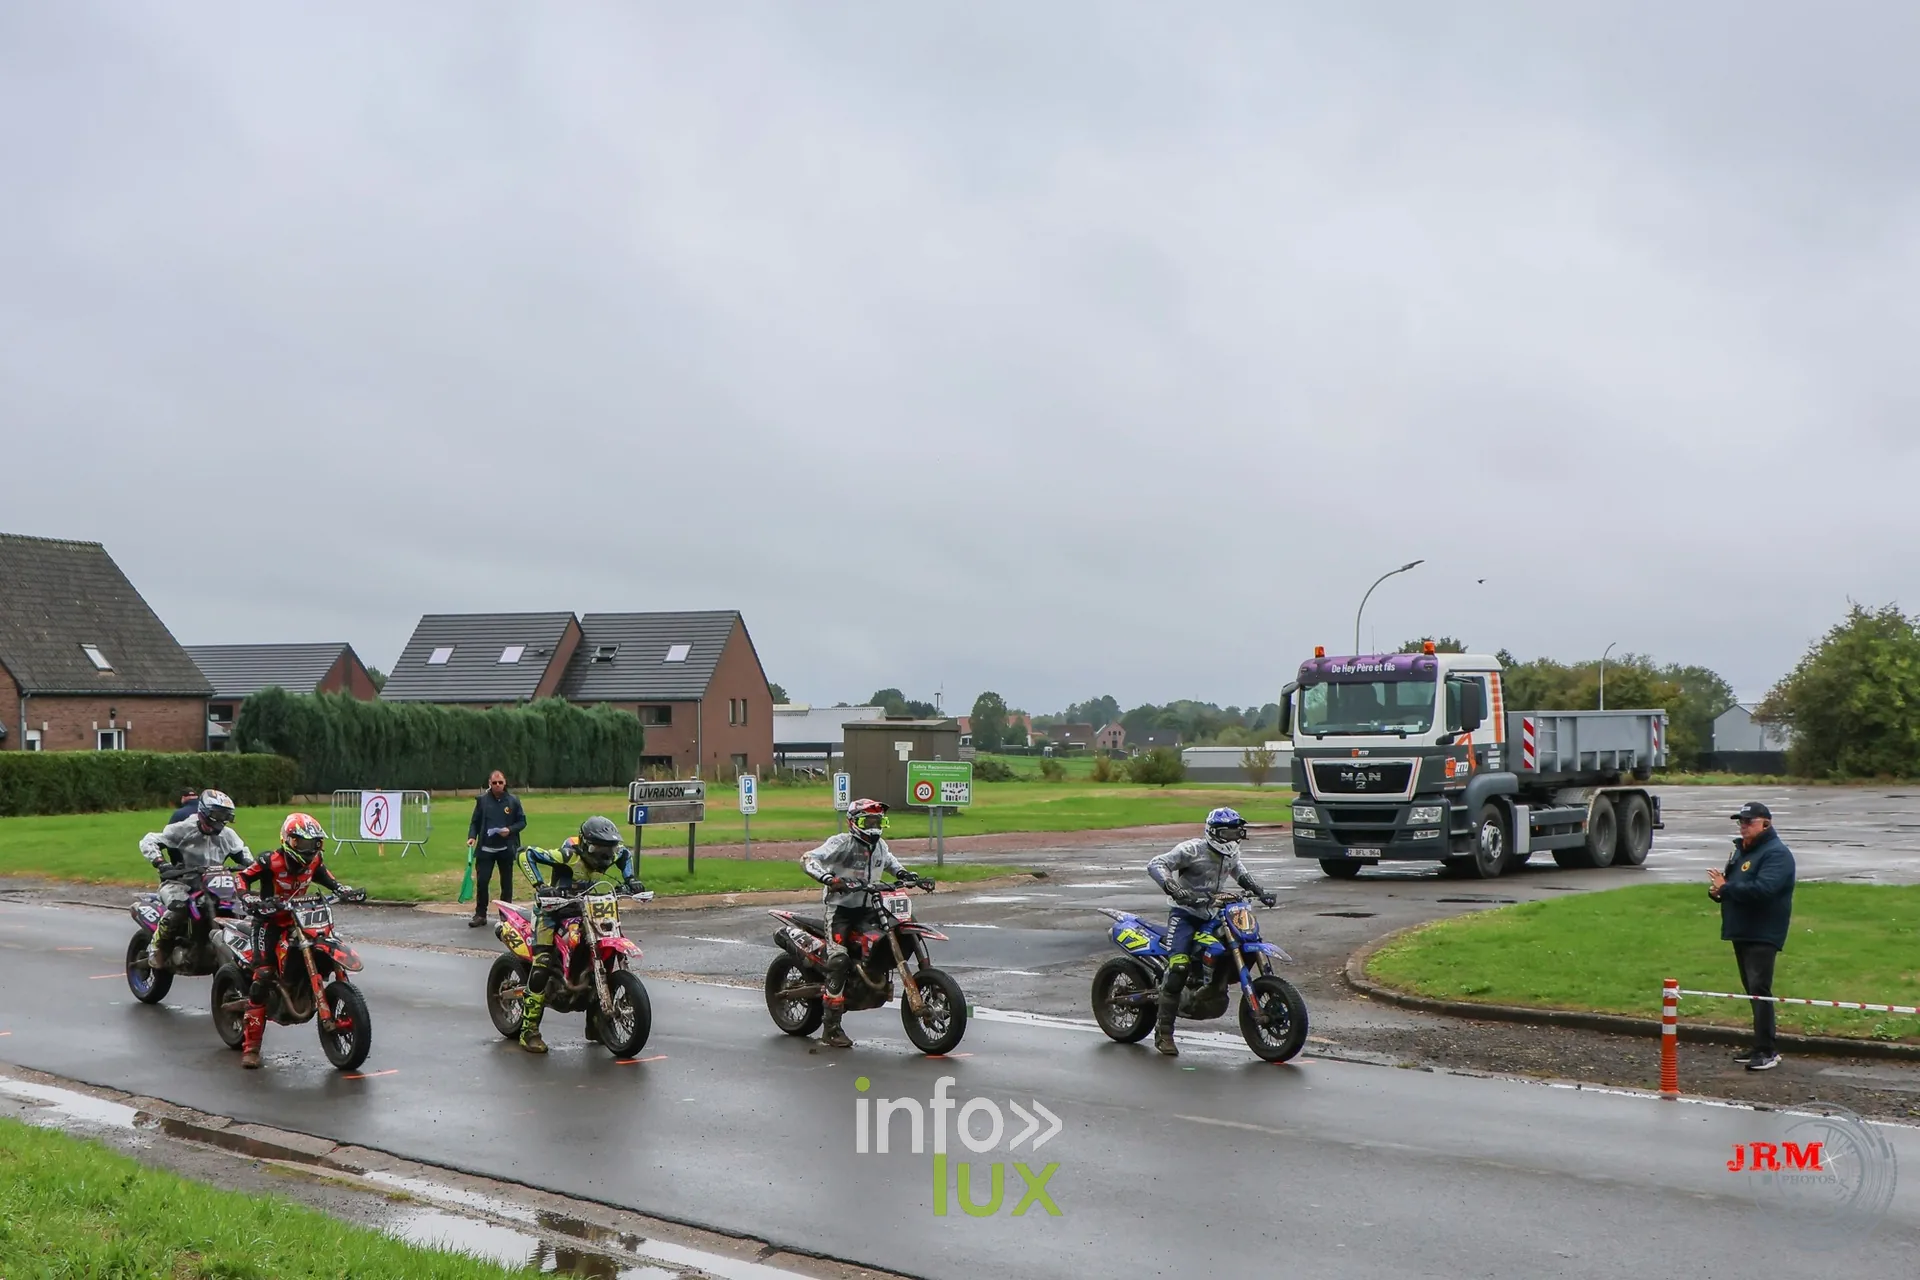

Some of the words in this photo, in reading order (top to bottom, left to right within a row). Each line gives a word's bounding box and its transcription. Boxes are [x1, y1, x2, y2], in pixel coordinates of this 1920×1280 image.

[1331, 664, 1341, 674] De
[1342, 664, 1356, 674] Hey
[1356, 662, 1373, 673] Père
[1375, 662, 1383, 672] et
[1384, 661, 1396, 672] fils
[1340, 772, 1382, 782] MAN
[639, 786, 687, 799] LIVRAISON
[918, 787, 931, 797] 20
[637, 810, 645, 821] P
[207, 875, 234, 888] 46
[138, 905, 160, 923] 46
[592, 902, 615, 918] 84
[302, 909, 331, 927] 10
[1116, 928, 1149, 949] 17
